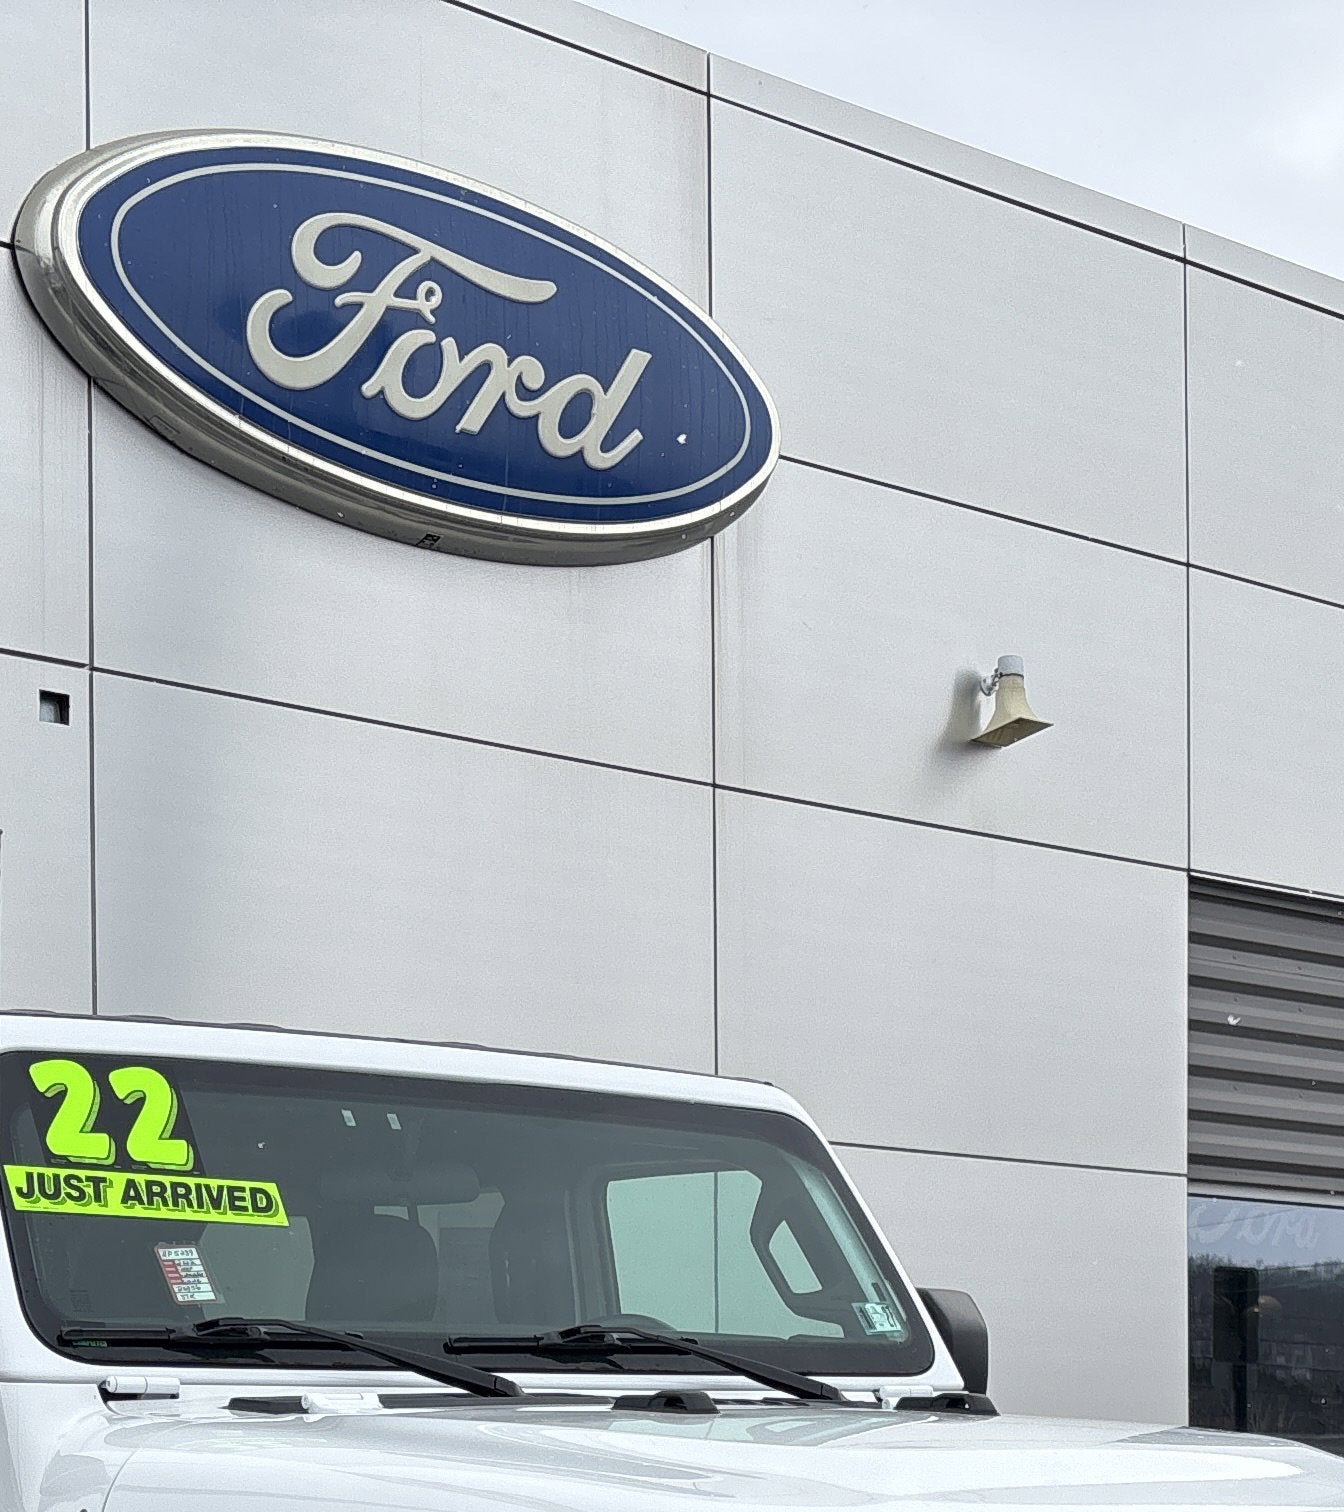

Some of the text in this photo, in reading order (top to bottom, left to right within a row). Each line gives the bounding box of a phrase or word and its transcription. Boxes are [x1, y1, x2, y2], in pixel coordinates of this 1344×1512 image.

[247, 212, 652, 471] Ford
[29, 1059, 193, 1170] 22
[15, 1171, 279, 1218] JUST ARRIVED
